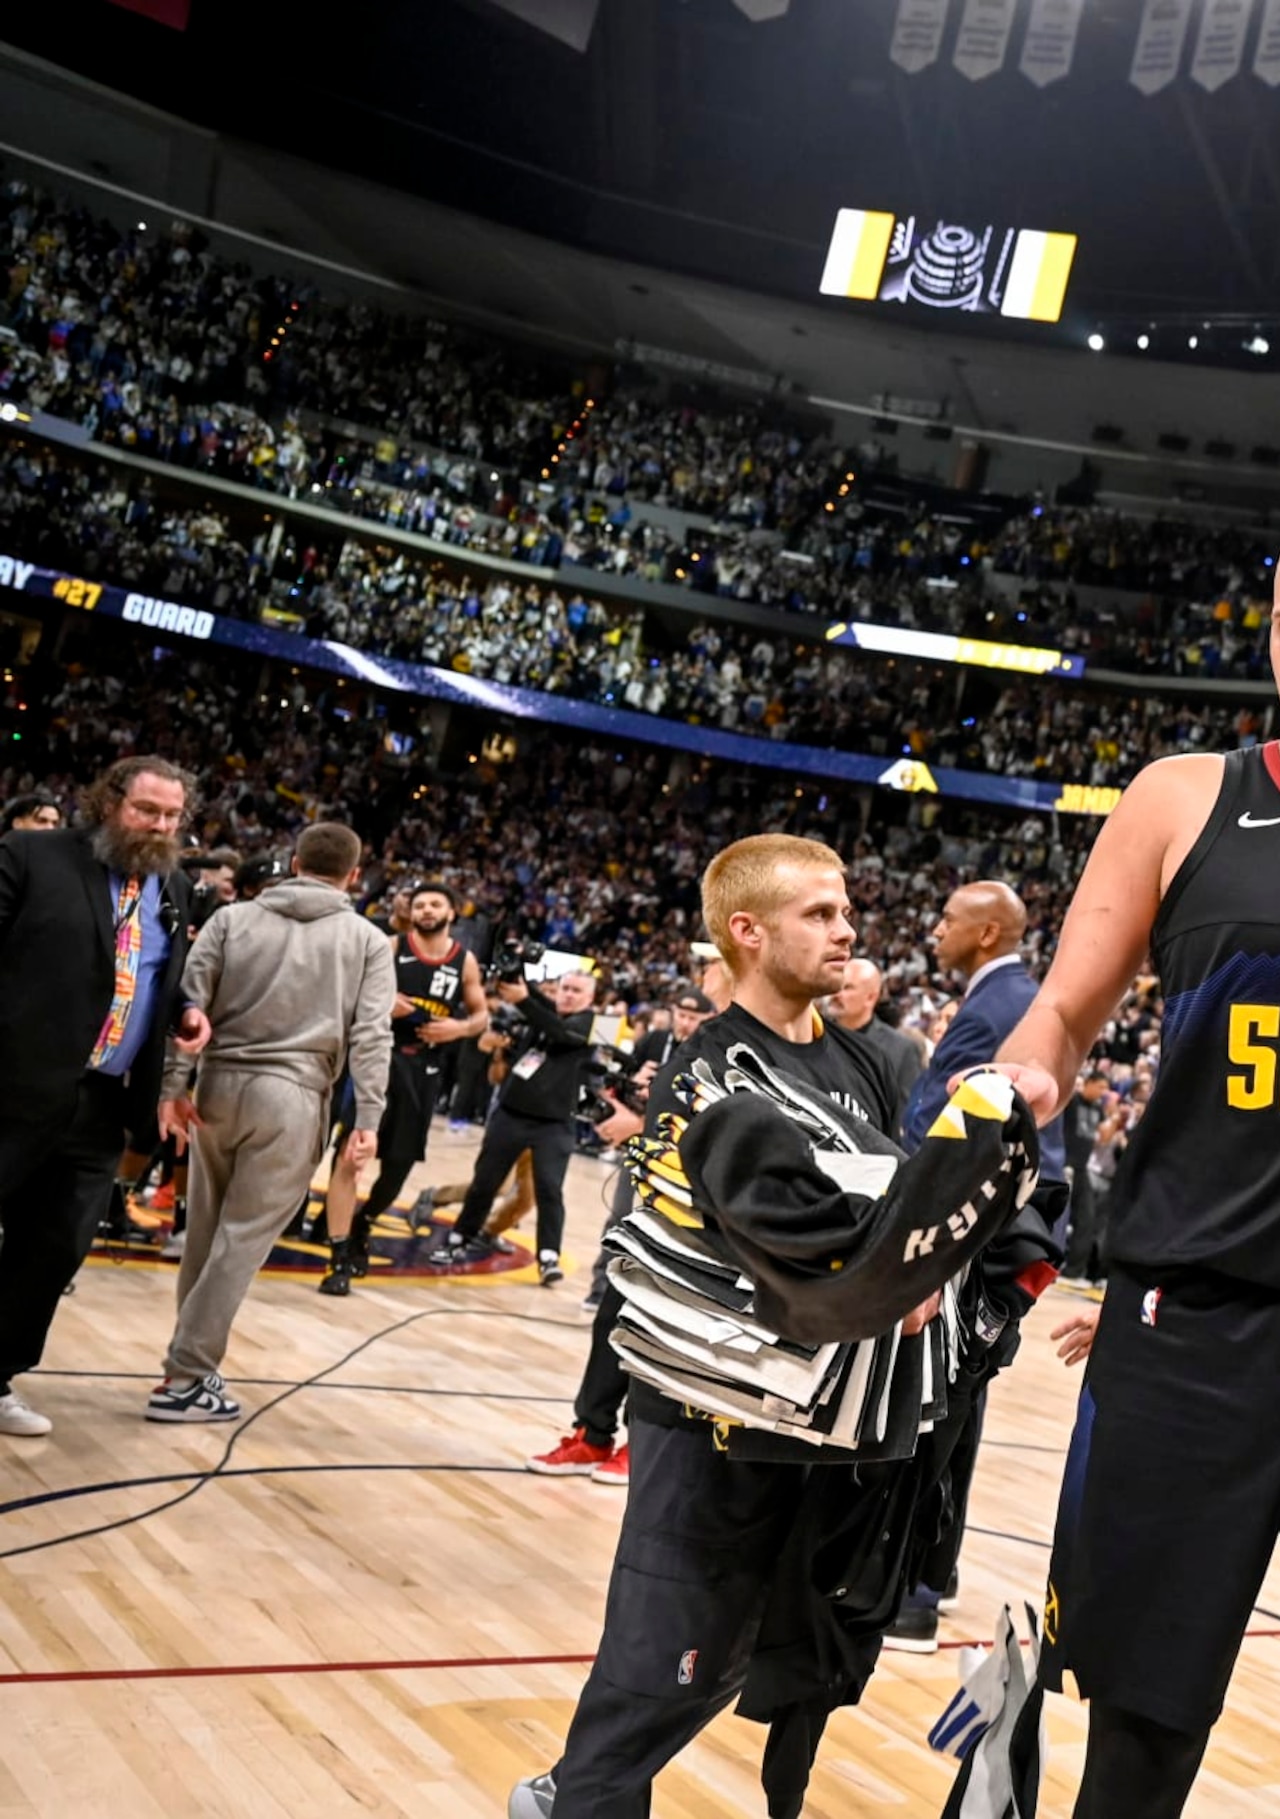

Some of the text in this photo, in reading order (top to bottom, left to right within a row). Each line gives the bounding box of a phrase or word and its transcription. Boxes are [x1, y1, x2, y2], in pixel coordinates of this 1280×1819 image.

[53, 577, 104, 610] #27
[122, 593, 215, 639] GUARD
[429, 970, 460, 1000] 27
